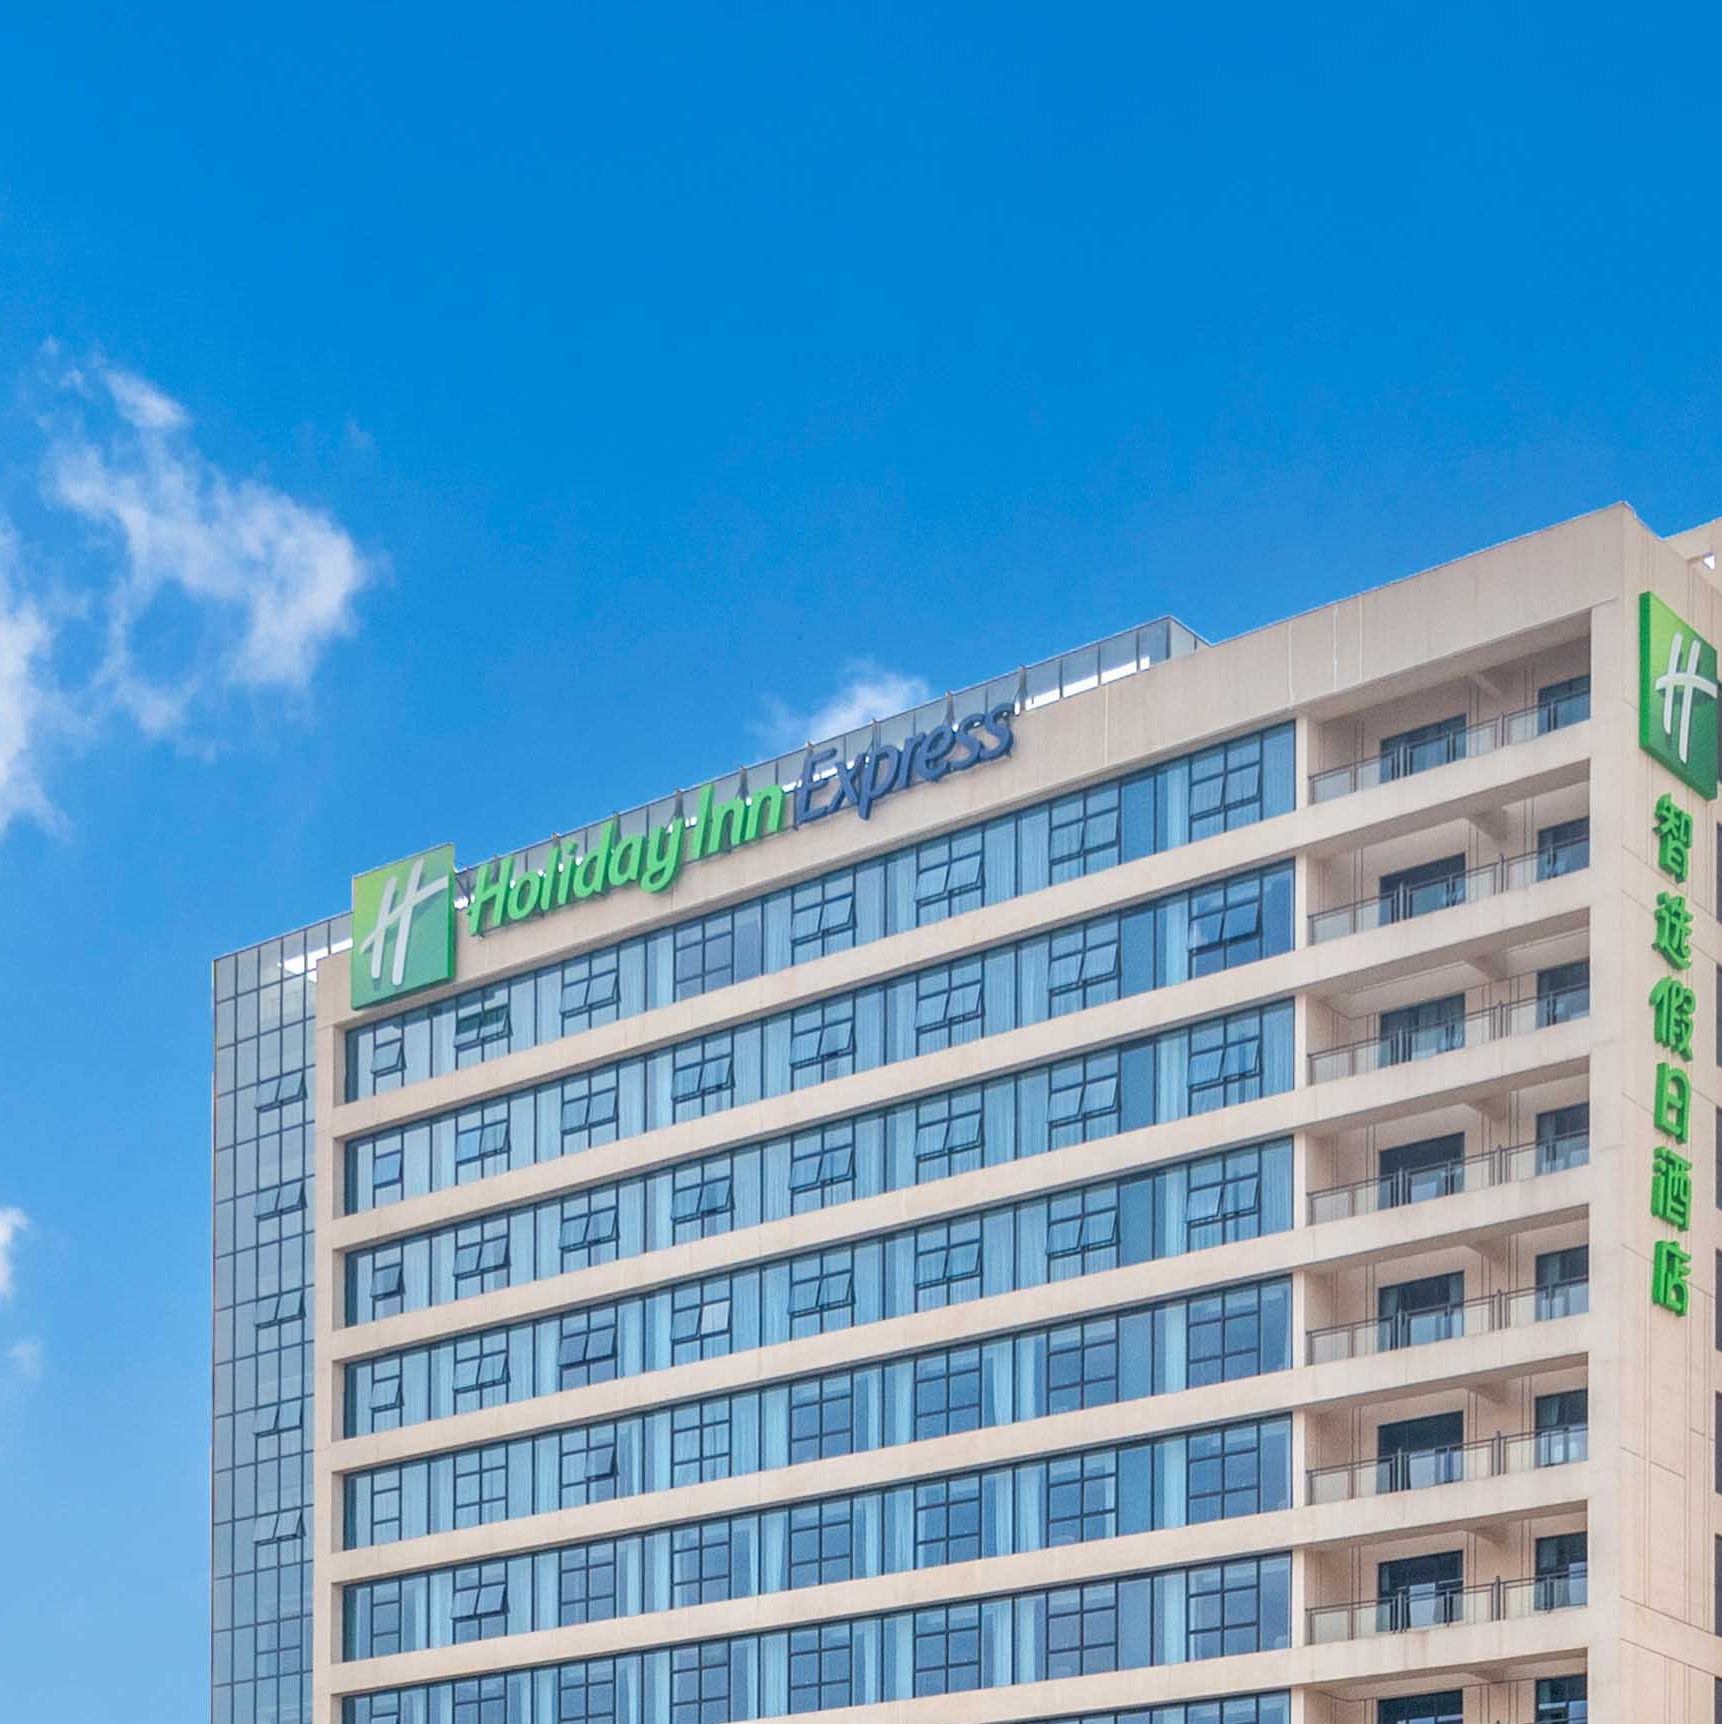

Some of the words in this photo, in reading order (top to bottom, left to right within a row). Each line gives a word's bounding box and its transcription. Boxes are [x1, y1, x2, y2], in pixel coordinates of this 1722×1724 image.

[467, 819, 684, 937] Holiday
[691, 783, 785, 861] Inn
[794, 703, 1015, 830] Express
[1650, 793, 1696, 1317] 智选假日酒店
